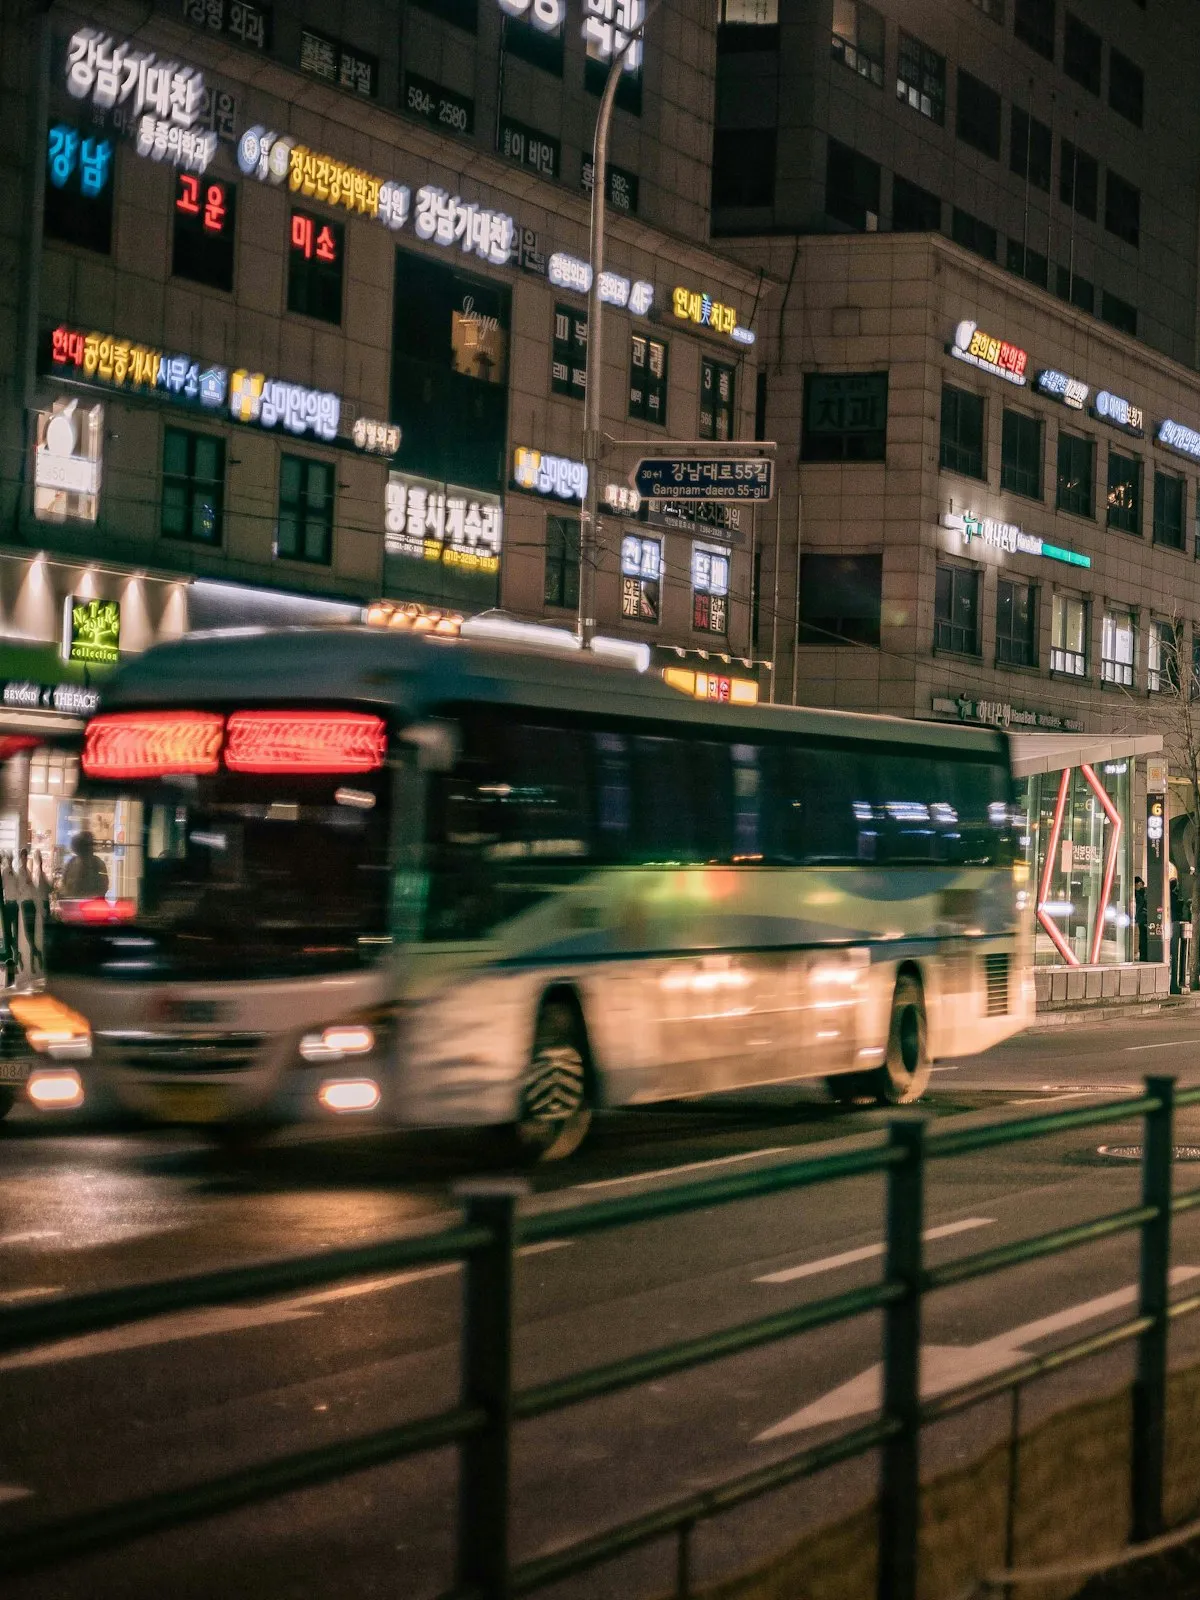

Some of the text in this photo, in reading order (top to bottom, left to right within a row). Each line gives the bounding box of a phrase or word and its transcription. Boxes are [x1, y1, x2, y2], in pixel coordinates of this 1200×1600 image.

[49, 126, 112, 196] 강남
[176, 173, 226, 231] 고운
[416, 187, 512, 263] 강남기대찬
[291, 214, 336, 260] 미소
[641, 470, 651, 479] 30
[672, 463, 767, 482] 강남대로55길
[653, 484, 767, 498] Gangnam-daero 55-gil
[71, 648, 117, 660] collection
[4, 686, 100, 708] BEYOND THEFACE
[1152, 803, 1162, 816] 6
